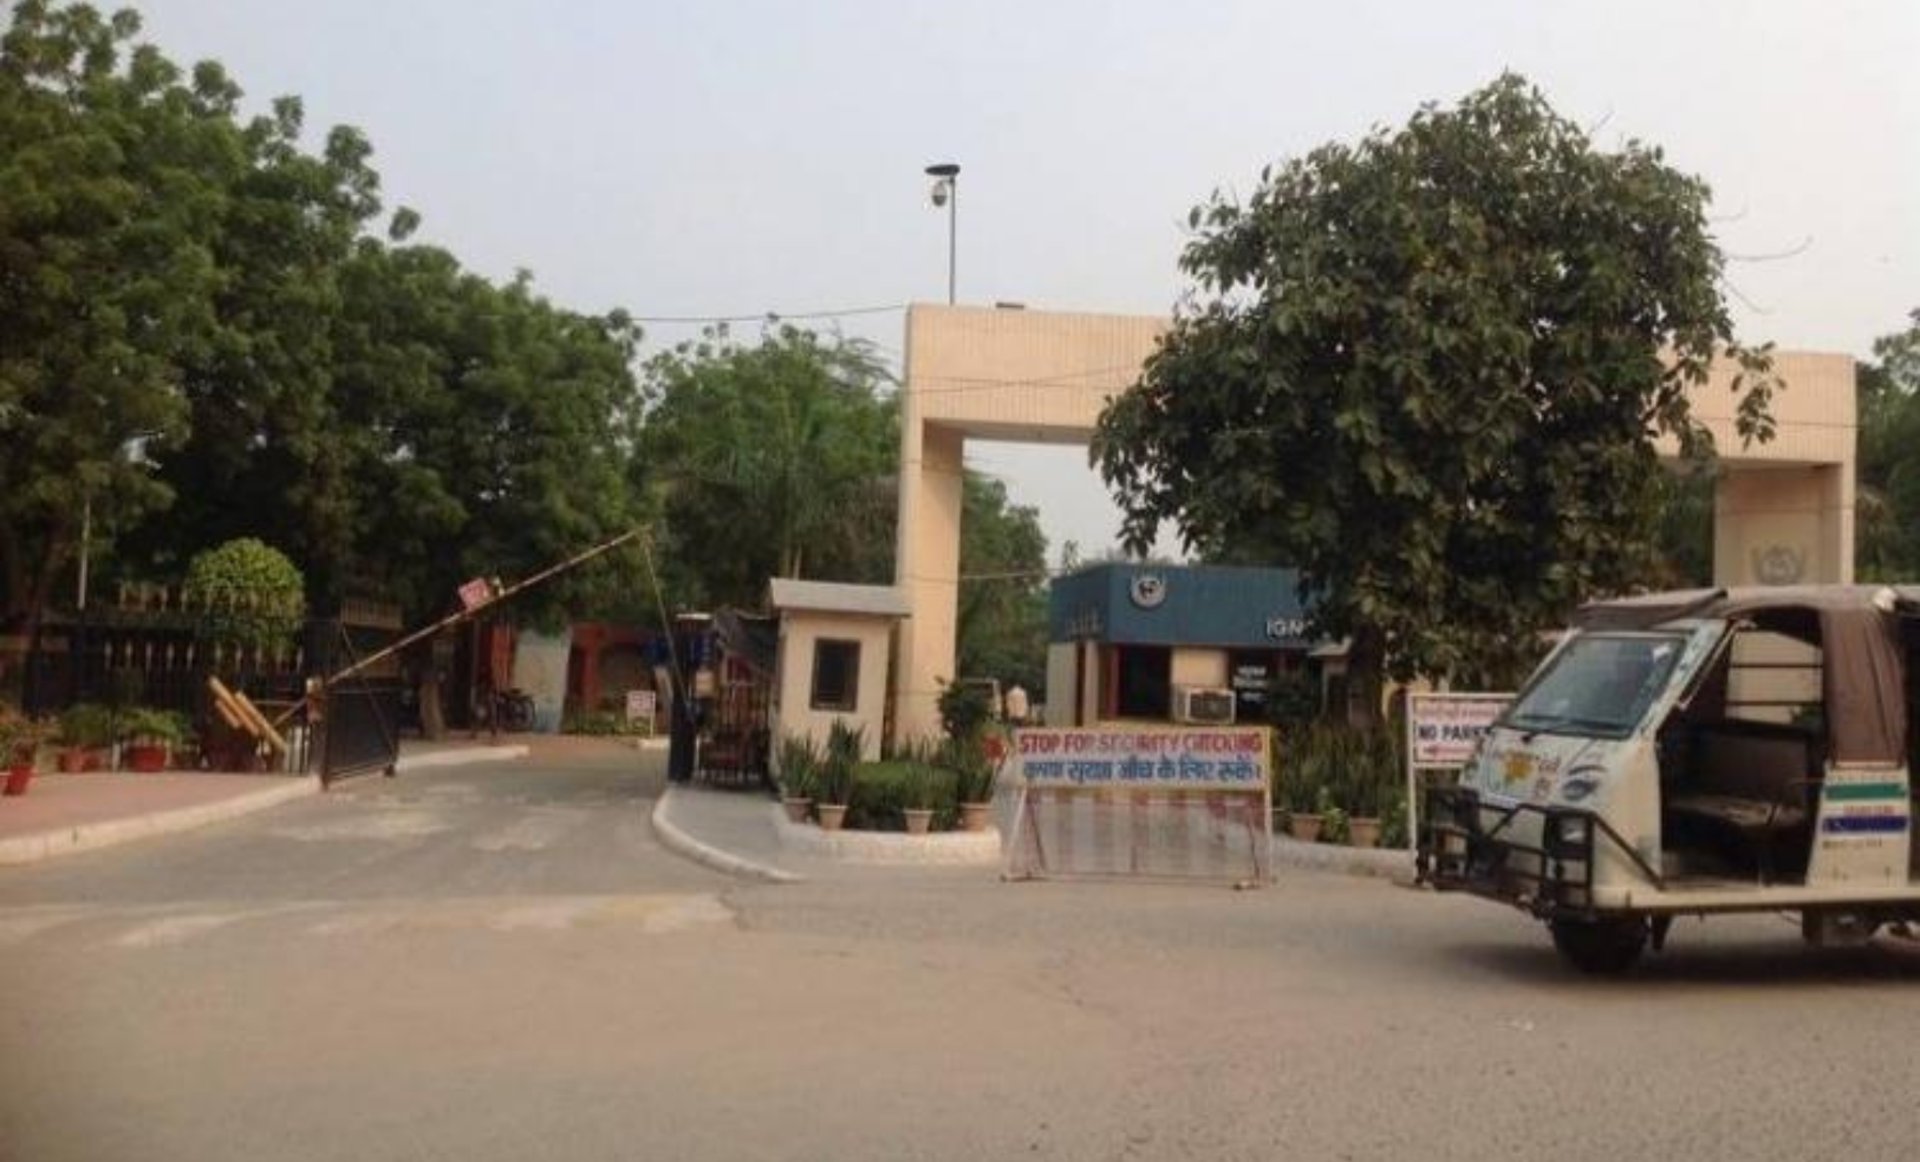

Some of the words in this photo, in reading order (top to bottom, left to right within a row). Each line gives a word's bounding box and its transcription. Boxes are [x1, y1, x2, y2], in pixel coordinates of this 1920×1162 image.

[1418, 724, 1437, 740] NO
[1019, 732, 1060, 755] STOP
[1064, 732, 1096, 754] FOR
[1182, 731, 1263, 754] CHECKING
